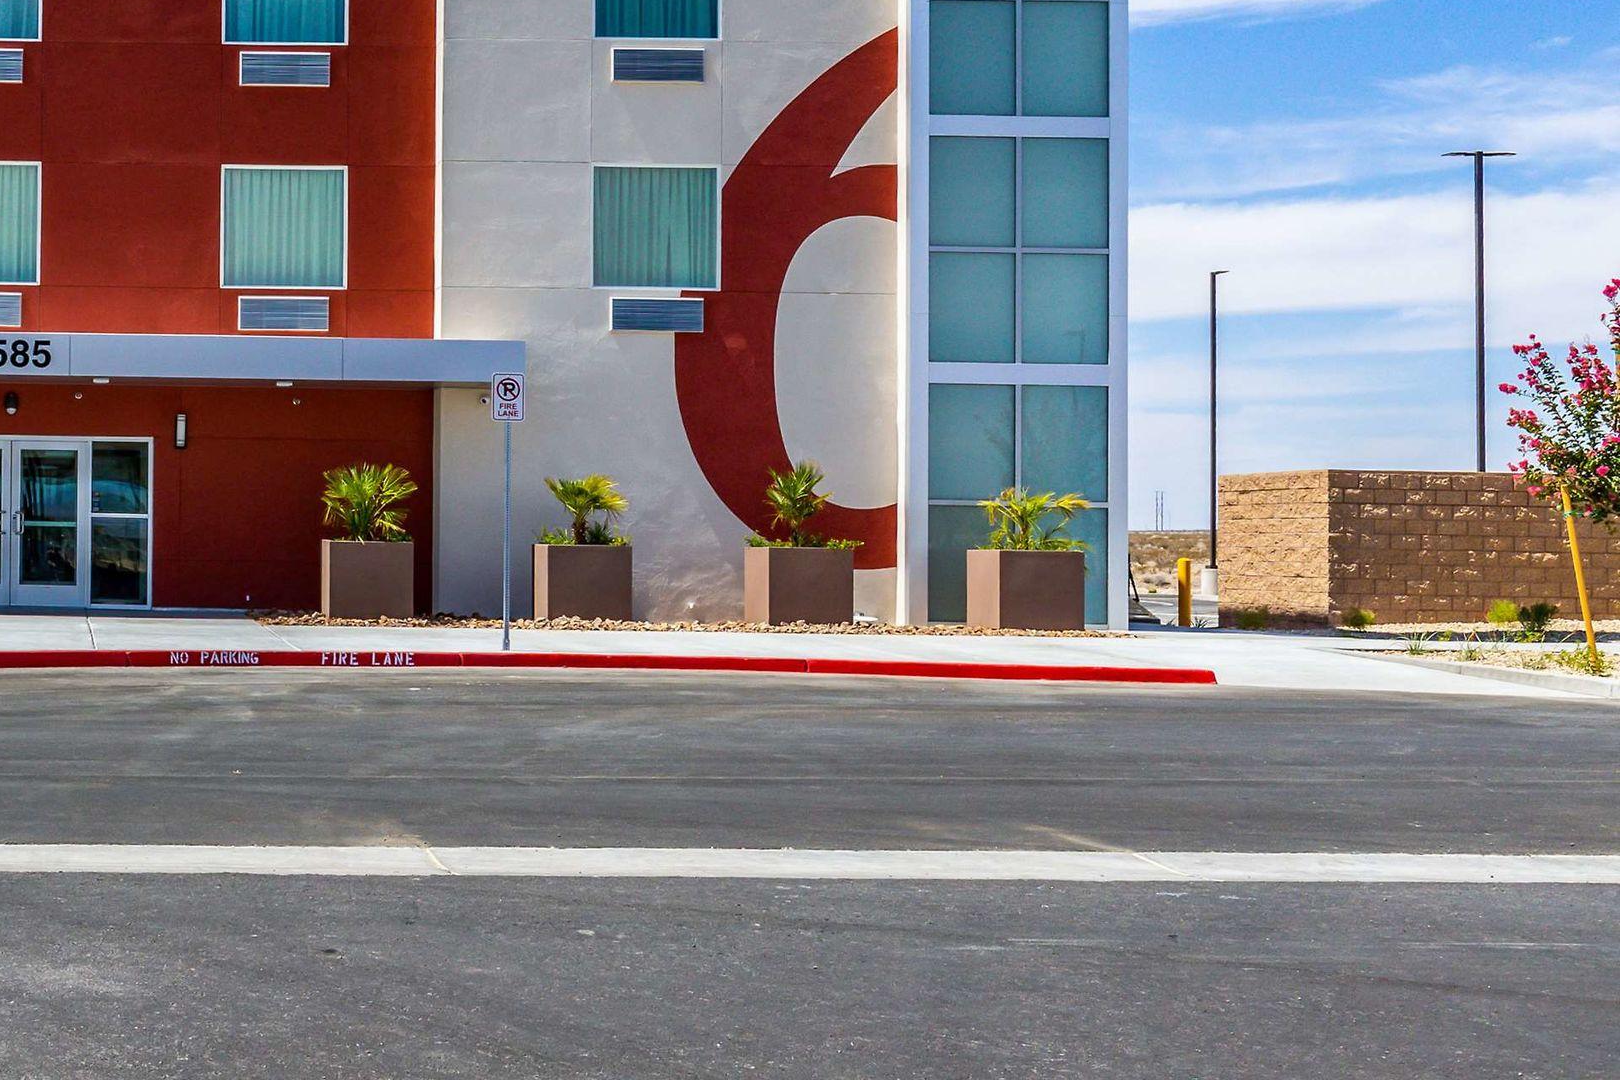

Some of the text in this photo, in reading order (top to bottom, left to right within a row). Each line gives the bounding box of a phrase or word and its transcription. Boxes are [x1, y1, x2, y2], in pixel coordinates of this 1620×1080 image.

[170, 651, 259, 664] NO PARKING
[321, 651, 415, 665] FIRE LANE
